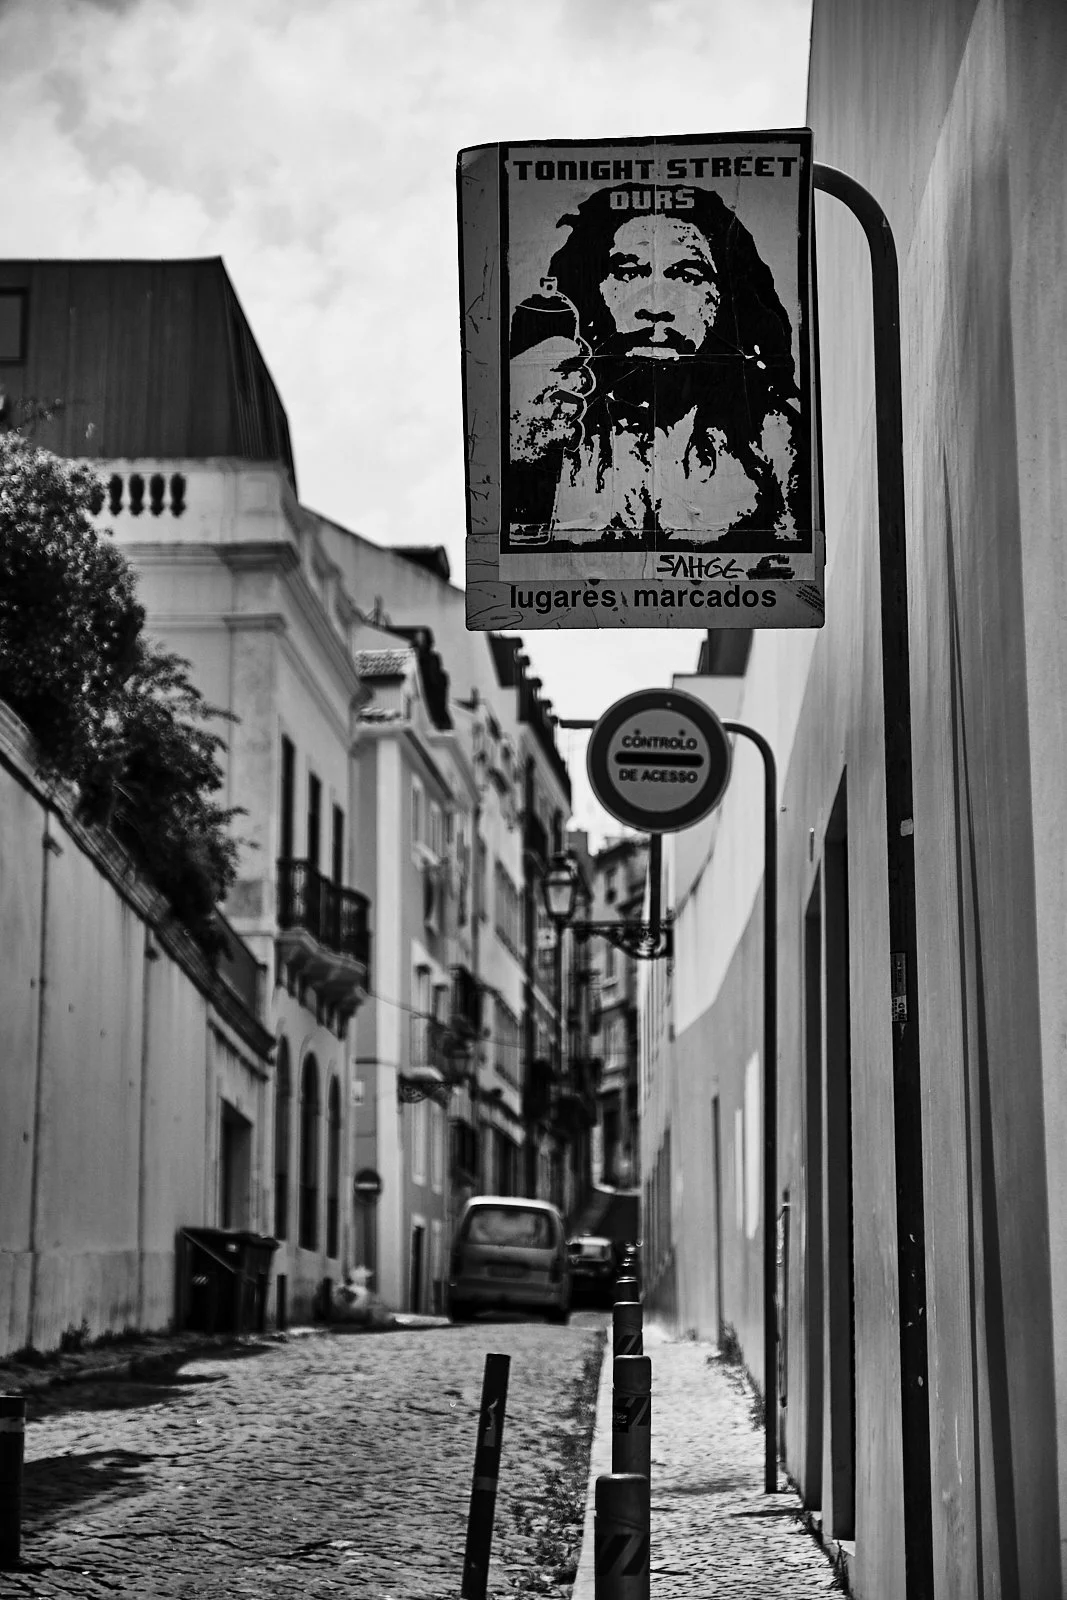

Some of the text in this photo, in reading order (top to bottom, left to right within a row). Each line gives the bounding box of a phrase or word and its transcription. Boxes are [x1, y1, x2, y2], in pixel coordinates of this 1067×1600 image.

[512, 156, 798, 181] TONIGHT STREET
[609, 188, 695, 210] OURS
[510, 585, 617, 614] lugares
[634, 584, 777, 608] marcados
[621, 735, 698, 751] CONTROLO
[619, 768, 698, 784] DE ACESSO
